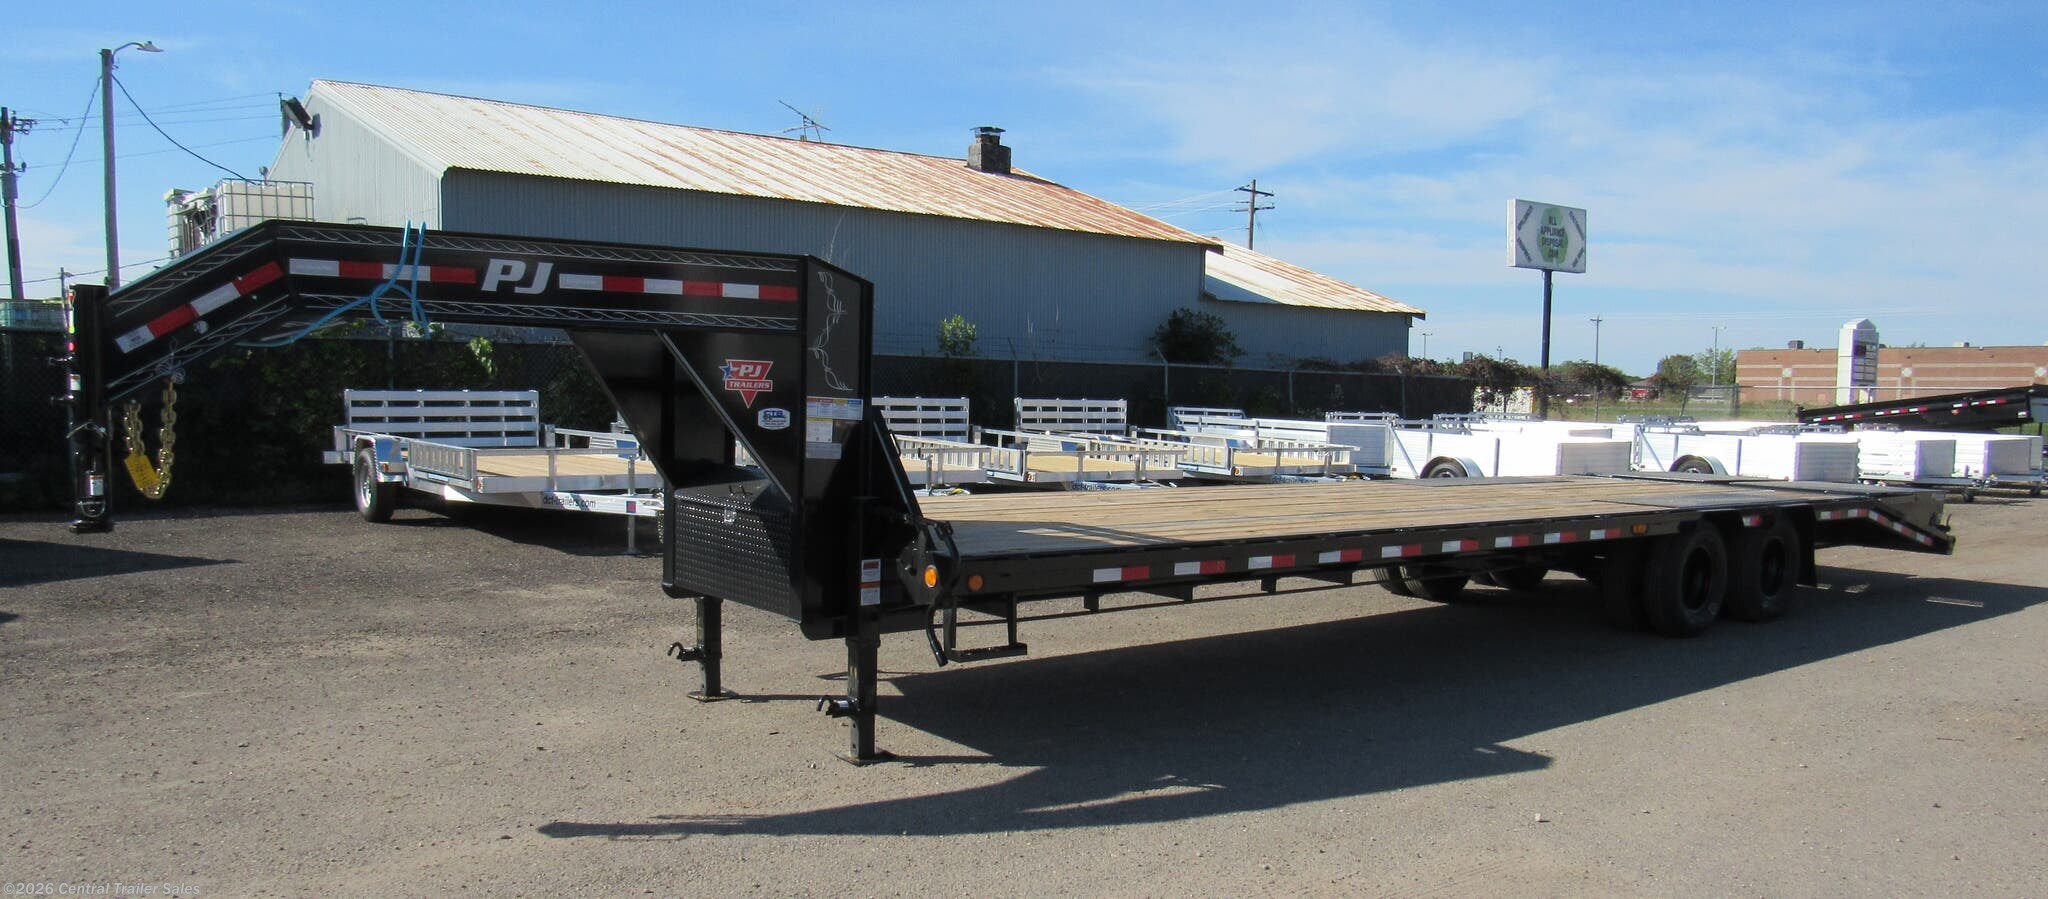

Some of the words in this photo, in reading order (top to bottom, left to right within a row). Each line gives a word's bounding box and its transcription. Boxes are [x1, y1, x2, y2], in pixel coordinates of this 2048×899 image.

[481, 258, 554, 294] PJ
[739, 364, 763, 377] PJ
[728, 381, 771, 390] TRAILERS
